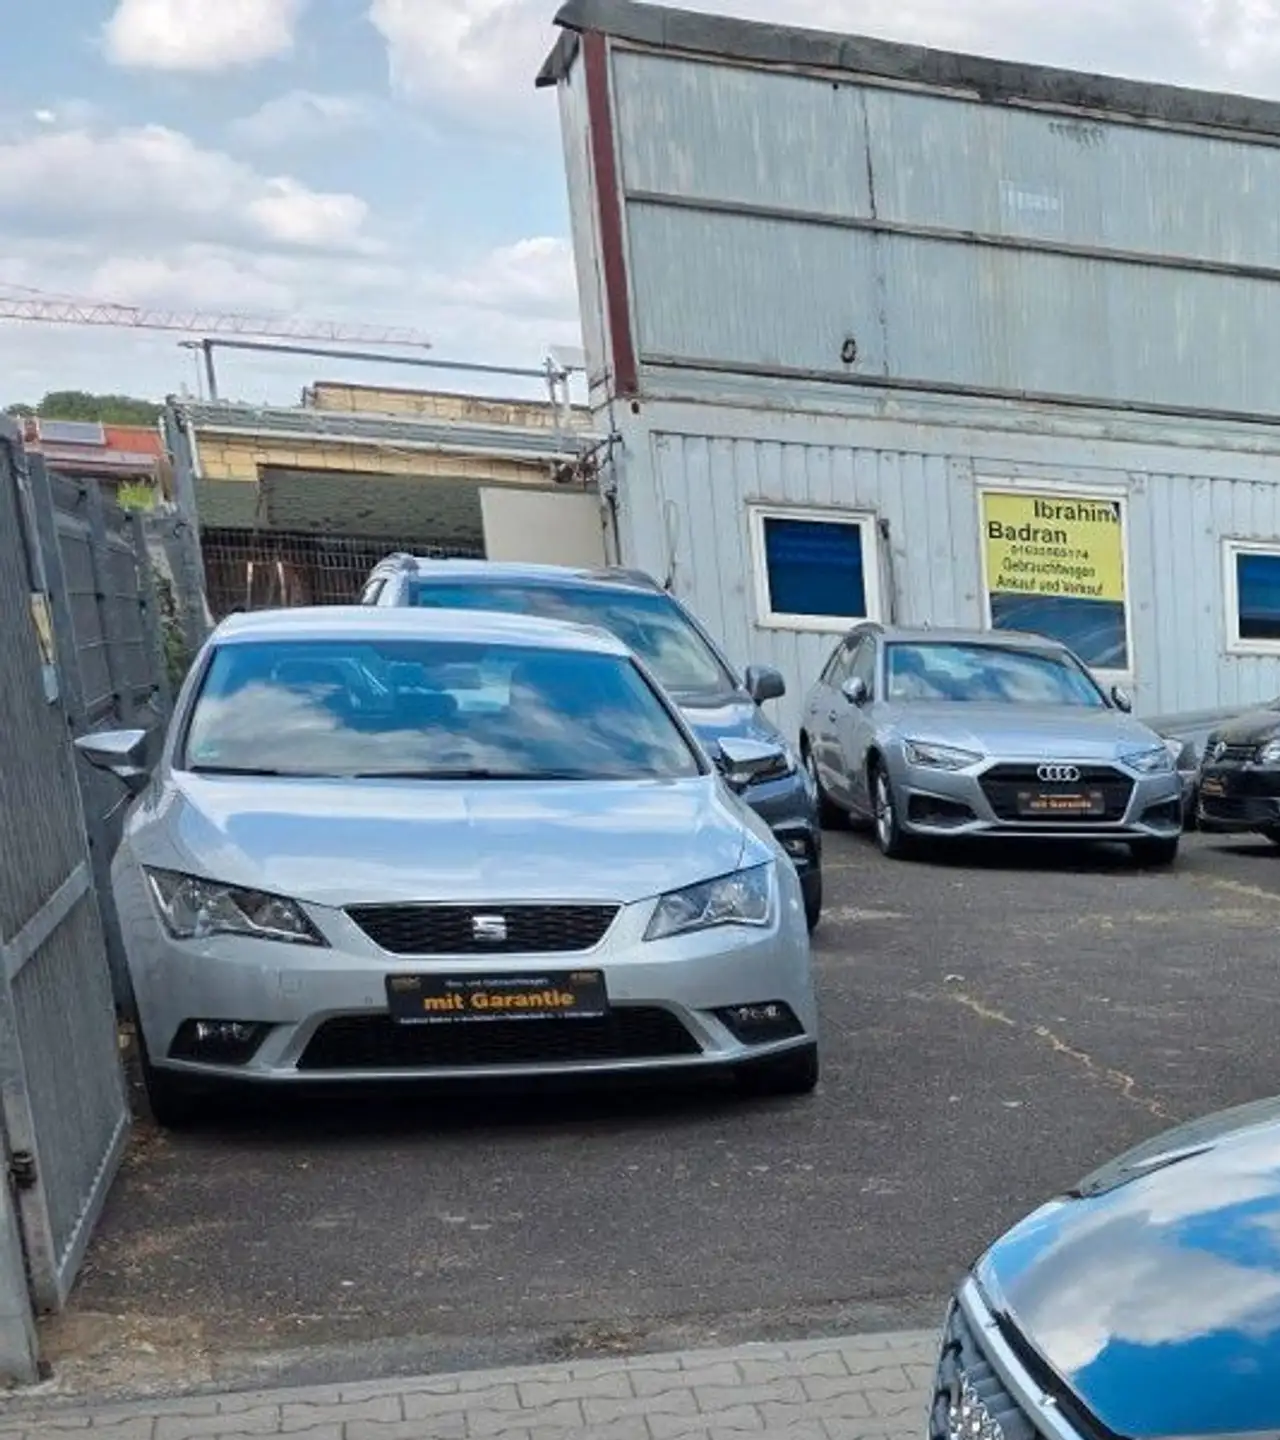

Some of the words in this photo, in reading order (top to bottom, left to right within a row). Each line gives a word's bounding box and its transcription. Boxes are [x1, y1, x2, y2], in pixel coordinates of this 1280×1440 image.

[1033, 499, 1119, 523] Ibrahim
[988, 520, 1068, 544] Badran
[1039, 578, 1060, 593] und
[423, 993, 464, 1011] mit
[469, 989, 575, 1009] Garantie
